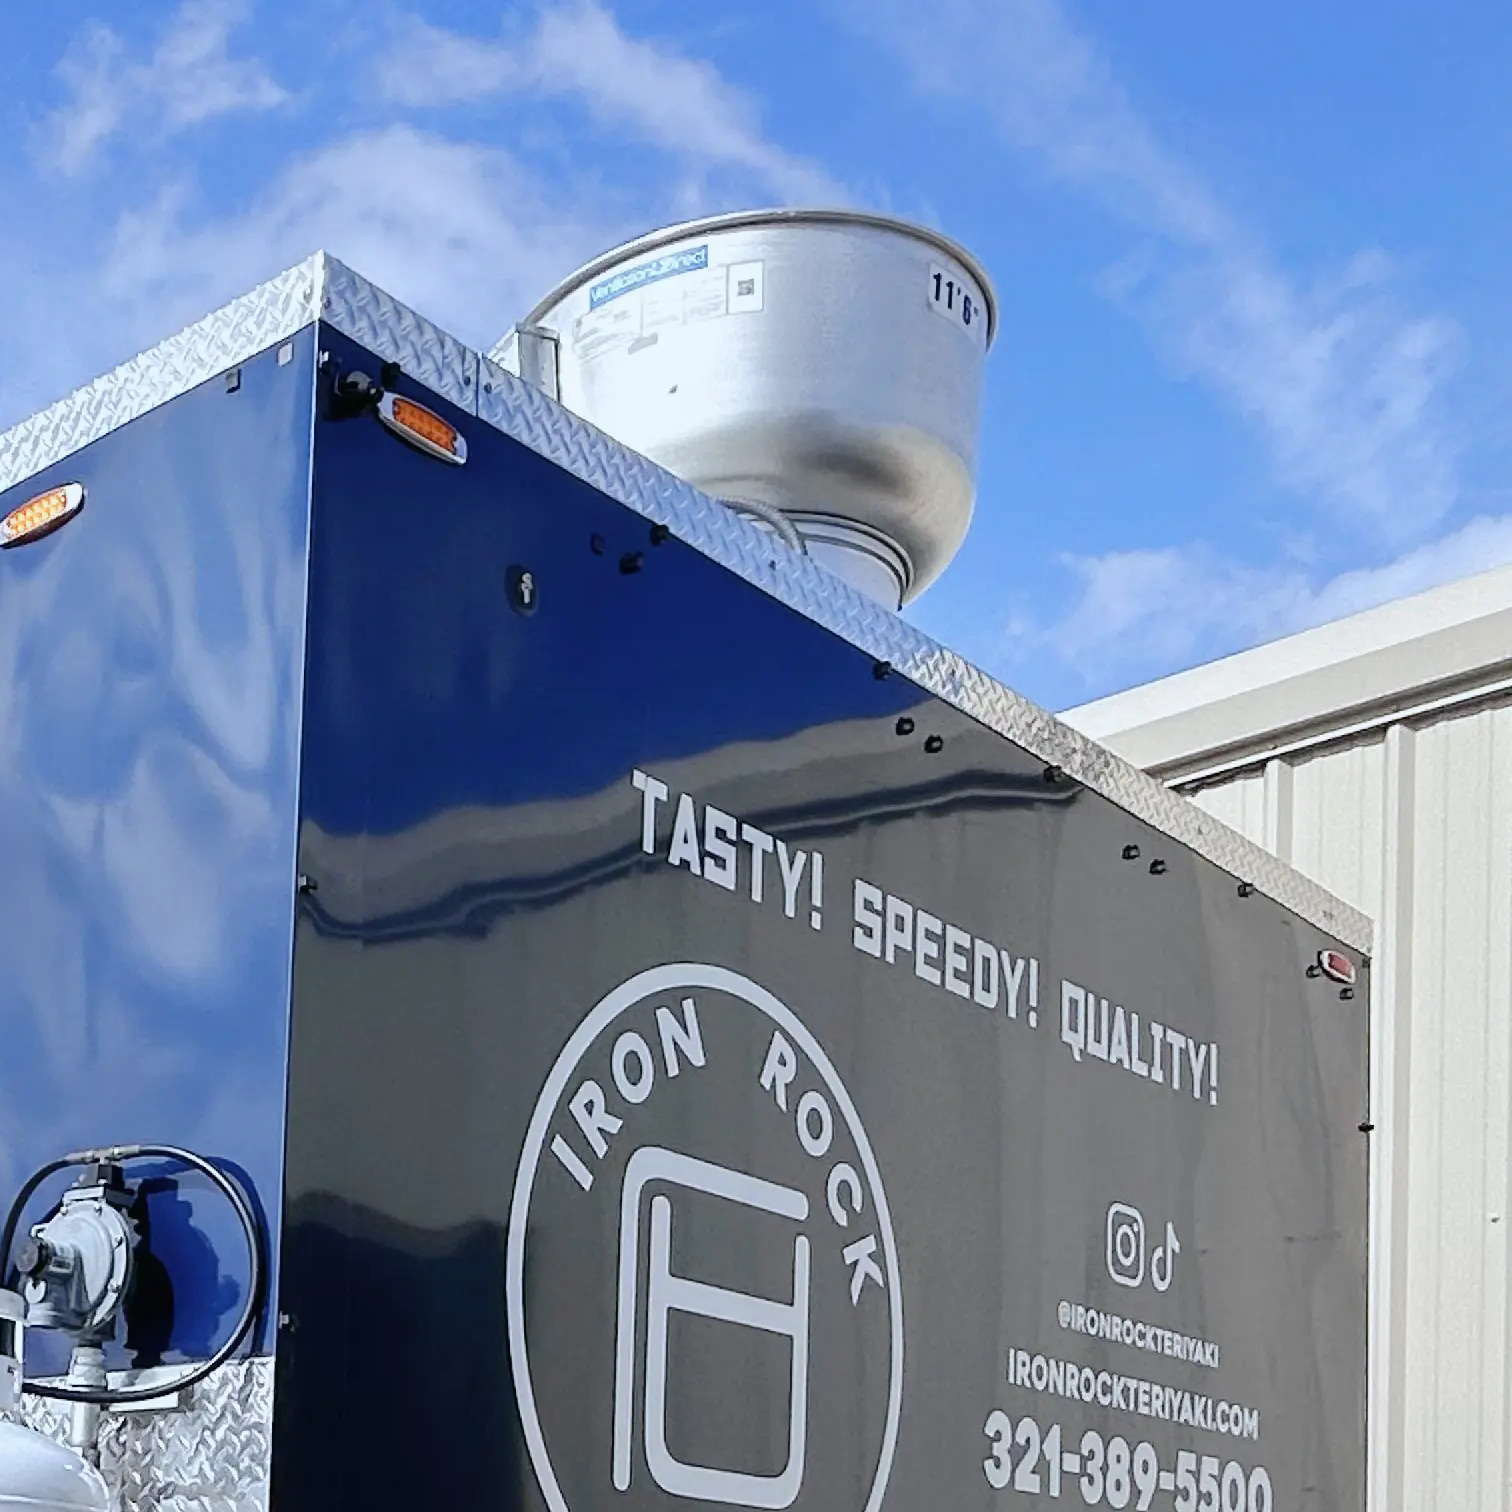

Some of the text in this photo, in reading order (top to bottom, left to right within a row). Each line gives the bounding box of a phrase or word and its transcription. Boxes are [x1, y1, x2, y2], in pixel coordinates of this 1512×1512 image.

[631, 769, 1218, 1106] TASTY! SPEEDY! QUALITY!
[550, 998, 884, 1307] IRON ROCK
[1007, 1347, 1260, 1440] IRONROCKTERIYAKI.COM
[1057, 1300, 1220, 1369] @IRONROCKTERIYAKI
